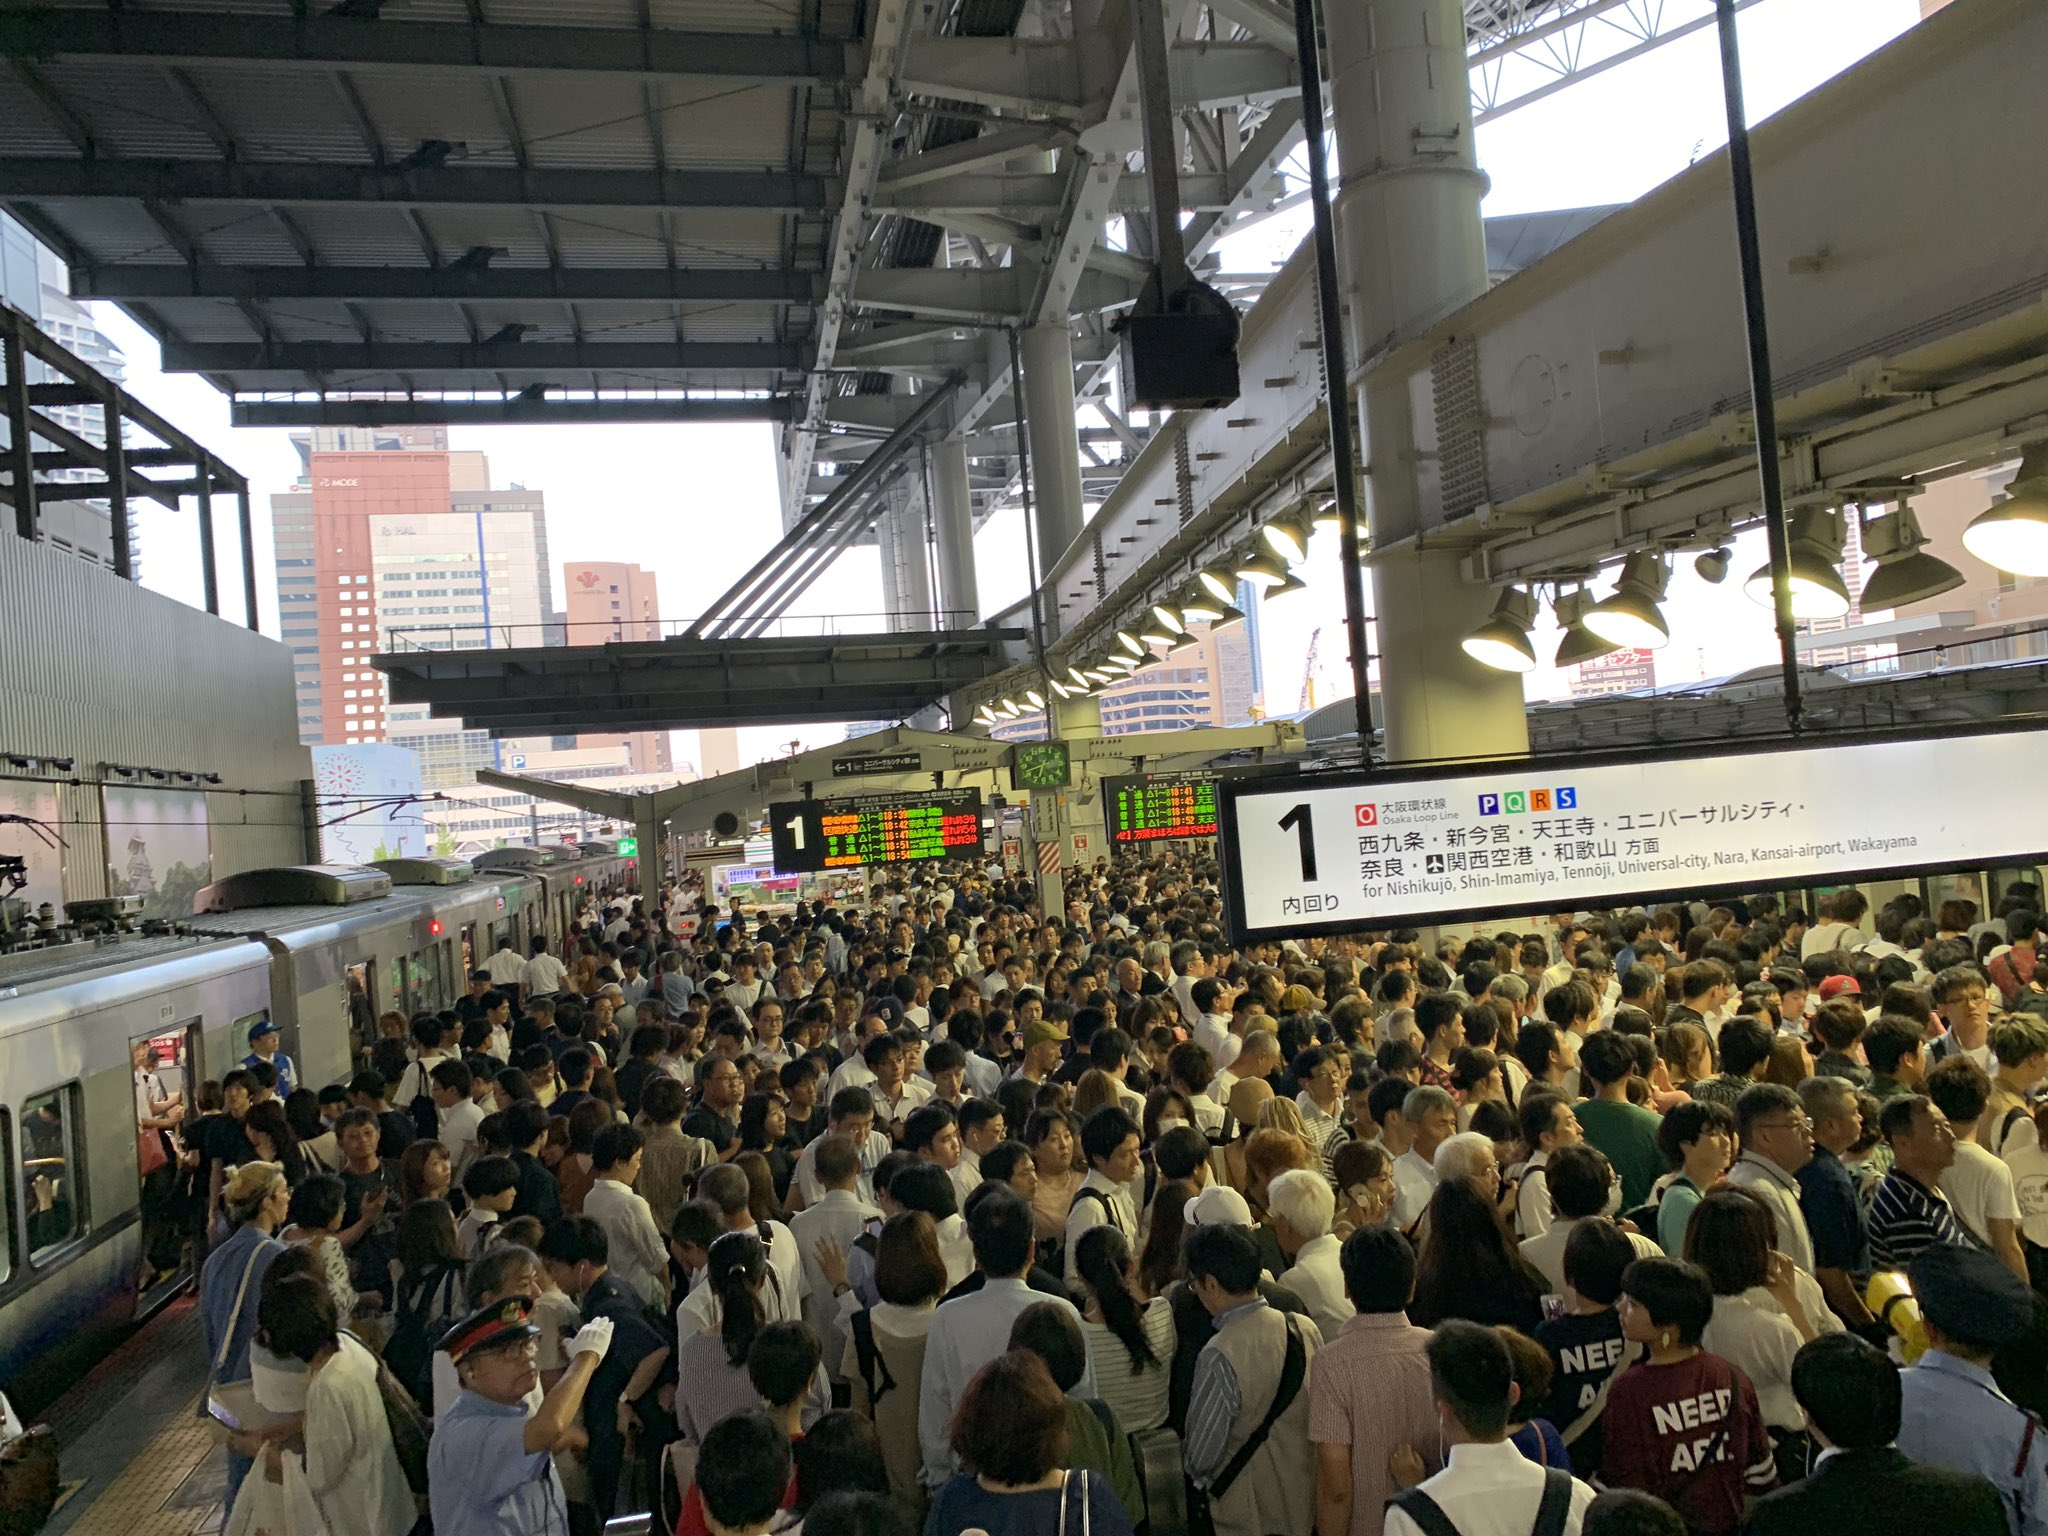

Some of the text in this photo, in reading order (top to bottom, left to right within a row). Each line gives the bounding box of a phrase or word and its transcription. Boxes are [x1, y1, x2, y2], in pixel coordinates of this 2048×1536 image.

[332, 479, 359, 487] MODE
[1382, 798, 1447, 814] 大阪環状線
[1507, 794, 1524, 812] Q
[884, 810, 908, 821] 18:39
[1414, 812, 1438, 824] Loop
[1439, 810, 1460, 820] Line
[884, 819, 909, 830] 18:42
[786, 816, 805, 850] 1
[885, 829, 910, 840] 18:47
[886, 840, 910, 851] 18:51
[1278, 804, 1318, 882] 1
[1626, 837, 1660, 856] 方面
[886, 850, 911, 862] 18:54
[1363, 834, 1917, 898] for Nishikujō, Shin-Imamiya, Tennōji, Universal-city, Nara, Kansai-airport, Wakayama
[1282, 893, 1340, 916] 内回り
[1560, 1337, 1641, 1375] NEE
